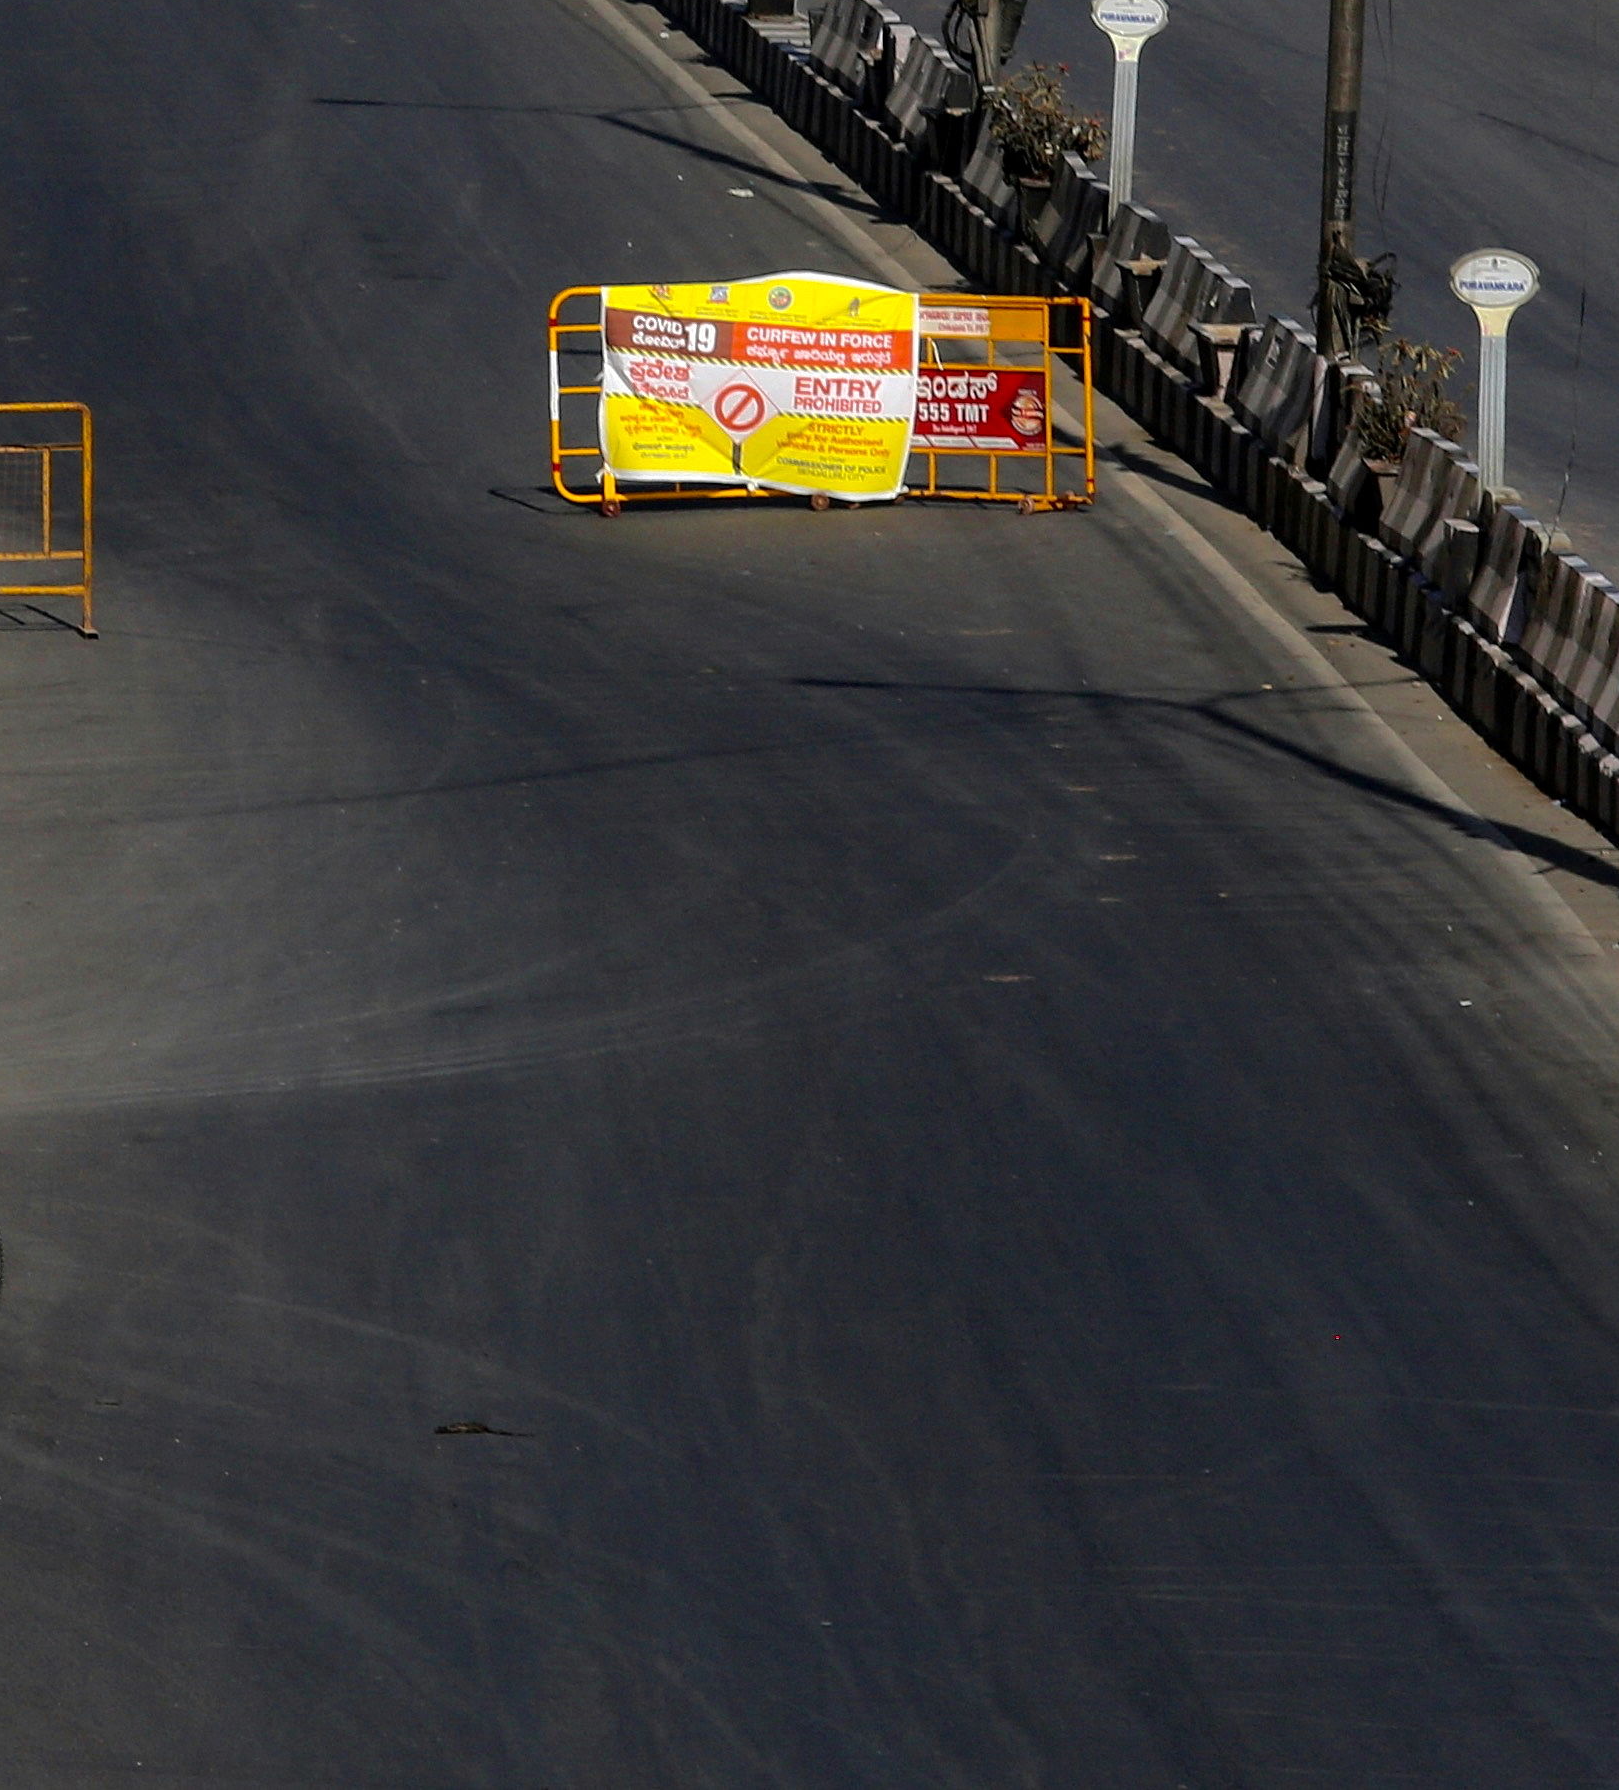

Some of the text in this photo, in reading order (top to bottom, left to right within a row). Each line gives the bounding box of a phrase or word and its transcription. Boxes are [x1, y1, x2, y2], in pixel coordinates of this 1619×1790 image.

[633, 315, 682, 336] COVID
[685, 322, 716, 353] 19
[747, 326, 893, 349] CURFEW IN FORCE
[795, 376, 882, 399] ENTRY
[793, 396, 883, 414] PROHIBITED
[919, 402, 990, 424] 555 TMT
[808, 422, 864, 435] STRICTLY
